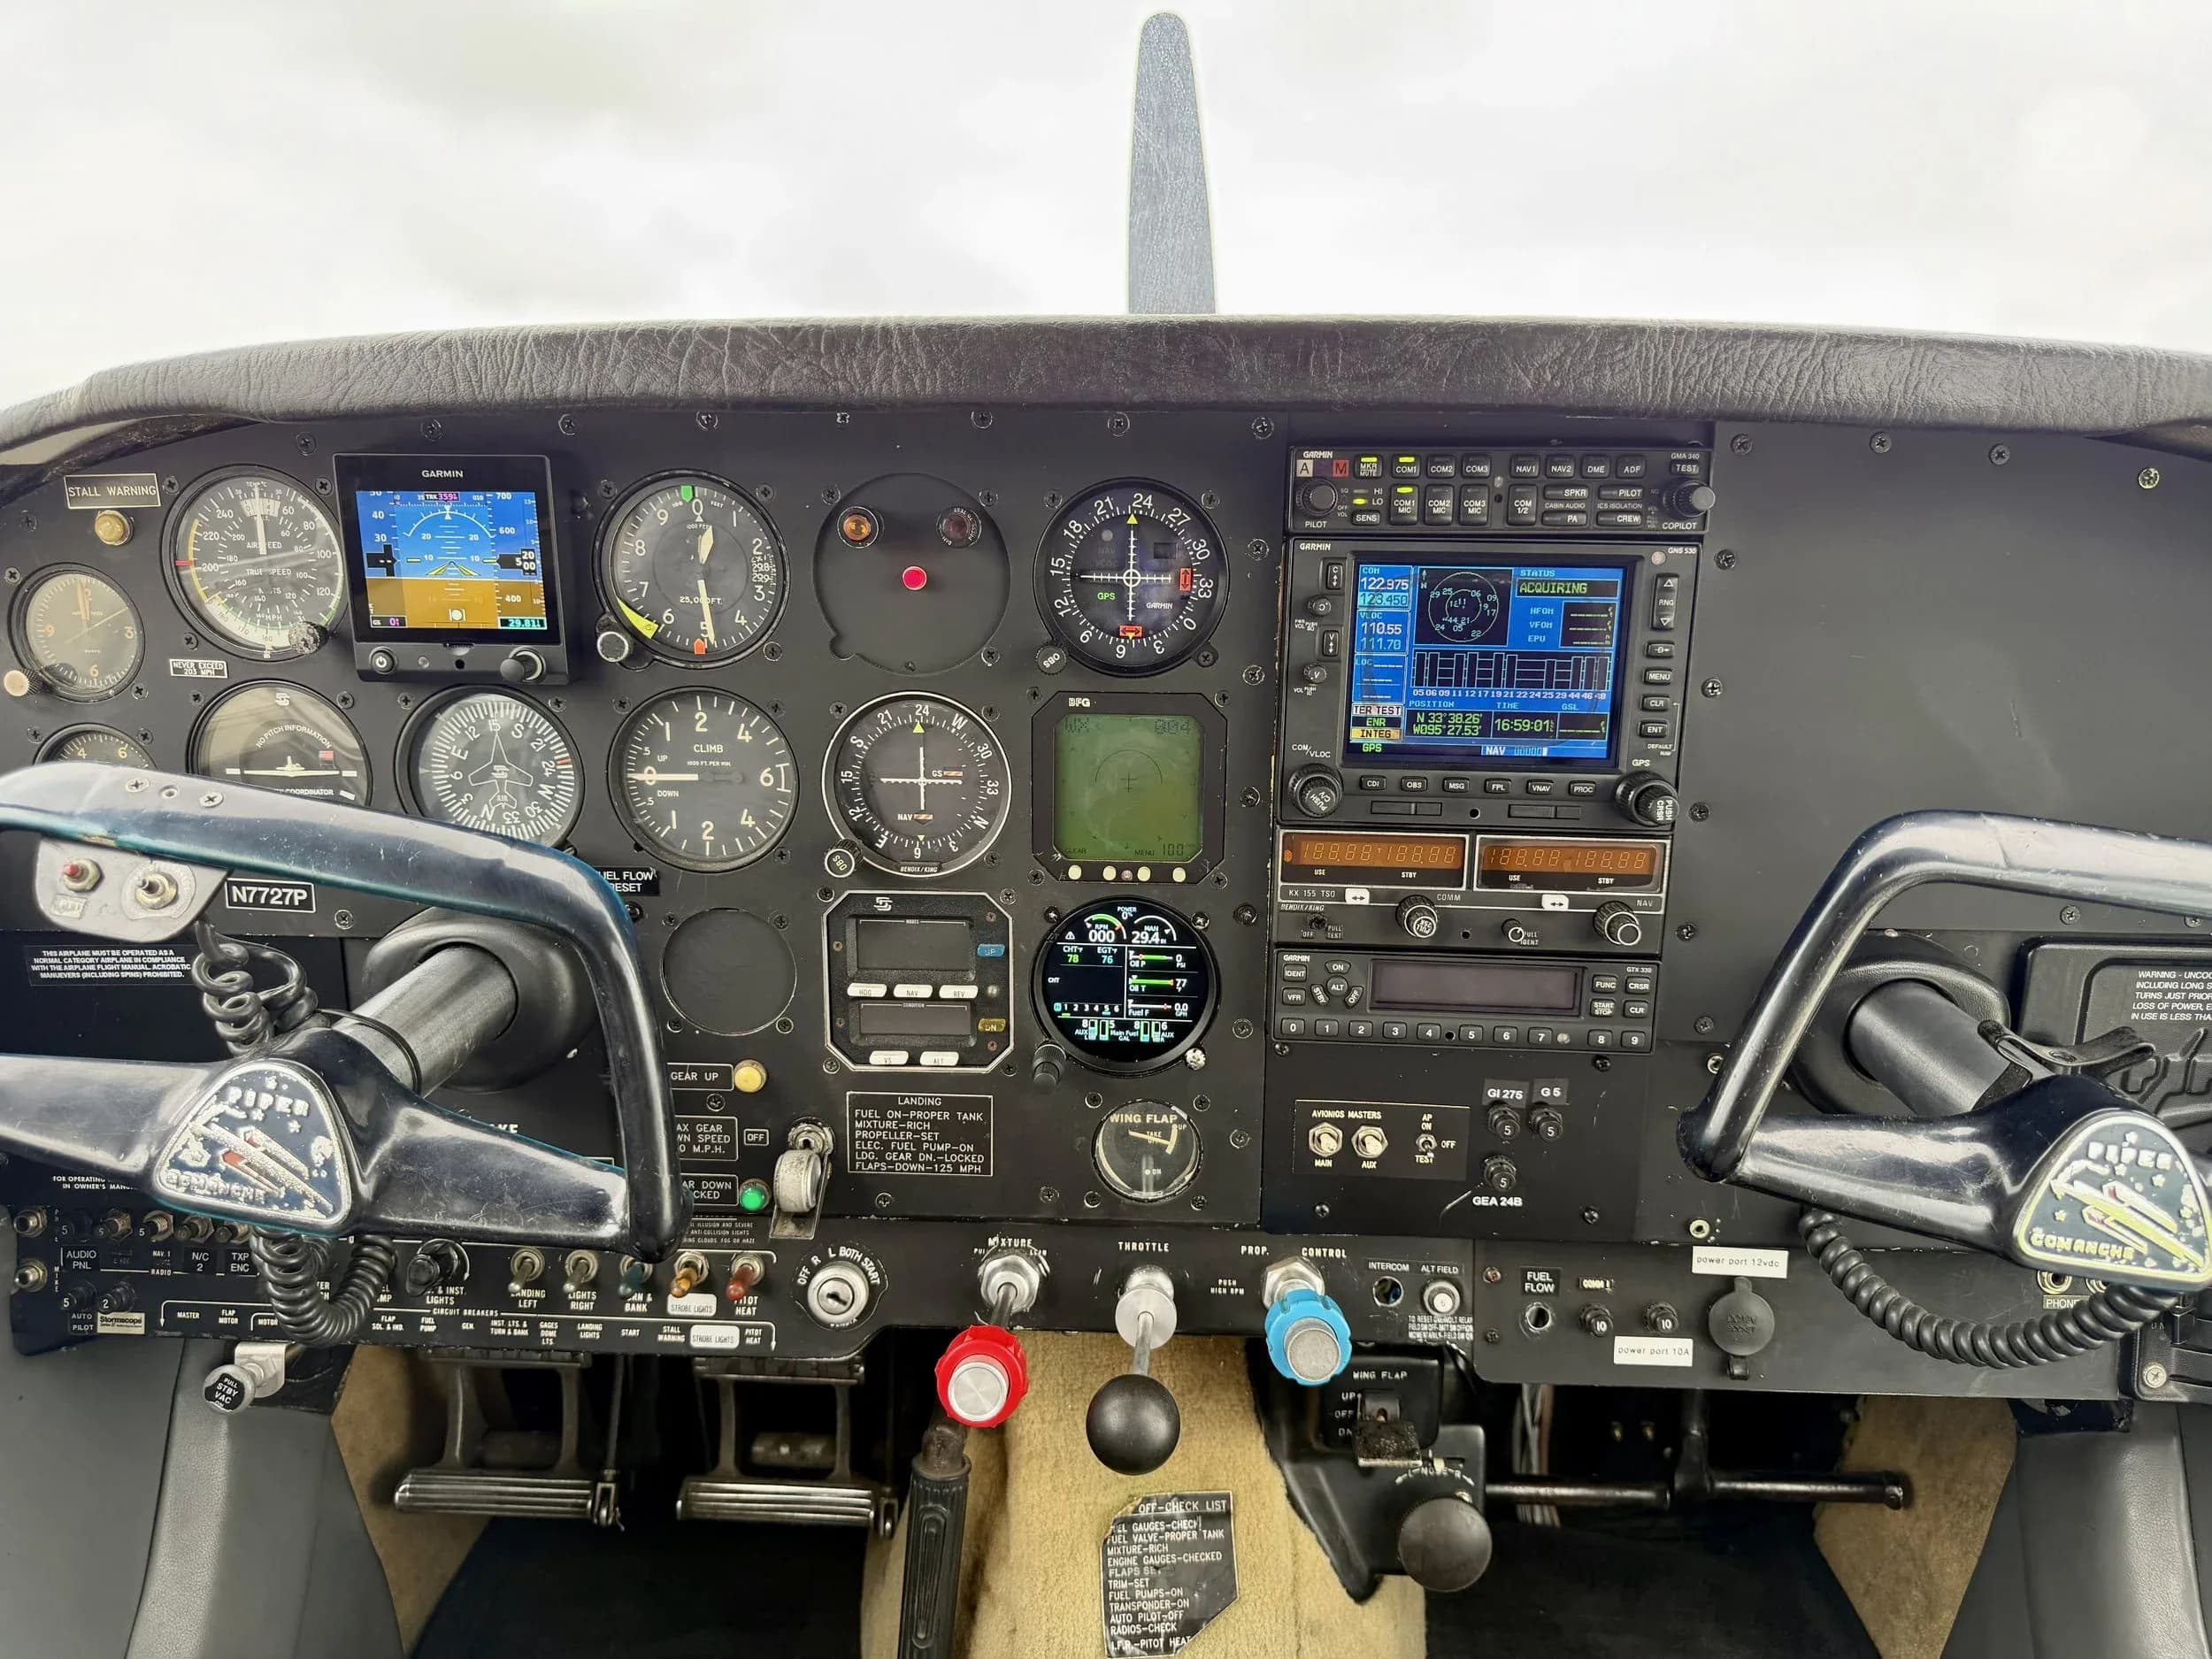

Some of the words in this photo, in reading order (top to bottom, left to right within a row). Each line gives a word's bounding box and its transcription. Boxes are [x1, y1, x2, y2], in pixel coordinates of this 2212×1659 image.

[69, 485, 101, 497] STALL
[107, 484, 157, 496] WARNING
[1618, 488, 1641, 497] PILOT
[1133, 493, 1153, 509] 24
[1394, 499, 1416, 508] COM1
[216, 510, 234, 518] 240
[1167, 507, 1191, 526] 27
[303, 521, 316, 531] 80
[374, 534, 387, 542] 30
[752, 538, 763, 555] 2
[1193, 539, 1210, 560] 30
[1299, 542, 1331, 551] GARMIN
[316, 550, 332, 559] 100
[202, 563, 219, 572] 200
[1361, 578, 1409, 590] 122.975
[1519, 582, 1587, 594] ACQUIRING
[754, 585, 765, 602] 3
[1097, 592, 1116, 601] GPS
[1360, 593, 1408, 606] 123.450
[1361, 622, 1402, 634] 110.55
[1361, 637, 1402, 650] 111.70
[1042, 653, 1061, 668] OBS
[1648, 672, 1671, 681] MENU
[1068, 697, 1090, 708] BFG
[915, 704, 929, 716] 24
[1366, 718, 1386, 726] ENR
[1494, 718, 1549, 732] 16:59:01
[1361, 729, 1391, 738] INTEG
[693, 743, 724, 754] CLIMB
[1363, 743, 1382, 753] GPS
[1486, 746, 1506, 756] NAV
[1632, 758, 1650, 767] GPS
[1573, 785, 1593, 794] PROC
[623, 870, 653, 880] FLOW
[232, 886, 307, 904] N7727P
[1088, 930, 1115, 942] 000
[671, 1071, 697, 1081] GEAR
[704, 1071, 718, 1081] UP
[1487, 1089, 1501, 1098] GI
[1502, 1090, 1523, 1100] 275
[898, 1096, 942, 1107] LANDING
[855, 1110, 880, 1118] FUEL
[887, 1110, 949, 1120] ON-PROPER
[956, 1111, 983, 1121] TANK
[1110, 1113, 1141, 1124] WING
[1146, 1114, 1178, 1125] FLAP
[1348, 1110, 1382, 1119] MASTERS
[855, 1120, 931, 1130] MIXTURE-RICH
[697, 1133, 730, 1143] SPEED
[747, 1133, 764, 1141] OFF
[855, 1131, 940, 1141] PROPELLER-SET
[856, 1141, 884, 1151] ELEC.
[890, 1141, 918, 1152] FUEL
[923, 1142, 974, 1152] PUMP-ON
[856, 1152, 879, 1161] LDG.
[885, 1152, 914, 1162] GEAR
[918, 1153, 984, 1164] DN.-LOCKED
[959, 1164, 981, 1173] MPH
[1472, 1196, 1498, 1206] GEA
[1500, 1197, 1522, 1207] 24B
[1118, 1241, 1170, 1252] THROTTLE
[1240, 1246, 1270, 1255] PROP.
[1302, 1248, 1347, 1257] CONTROL
[66, 1250, 96, 1259] AUDIO
[73, 1260, 91, 1270] PNL
[1368, 1262, 1409, 1271] INTERCOM
[1696, 1256, 1727, 1265] power
[1728, 1257, 1749, 1266] port
[1752, 1258, 1779, 1268] 12vdc
[1526, 1272, 1553, 1282] FUEL
[1525, 1282, 1555, 1293] FLOW
[1617, 1346, 1648, 1355] power
[1650, 1346, 1671, 1356] port
[1672, 1348, 1689, 1356] 10A
[217, 1382, 239, 1397] STBY
[214, 1391, 233, 1404] VAC
[1205, 1500, 1226, 1510] LIST
[1107, 1543, 1169, 1555] MIXTURE-RICH
[1107, 1556, 1138, 1566] ENGINE
[1143, 1552, 1222, 1565] GAUGES-CHECKED
[1108, 1578, 1149, 1589] TRIM-SET
[1110, 1622, 1178, 1635] RADIOS-CHECK
